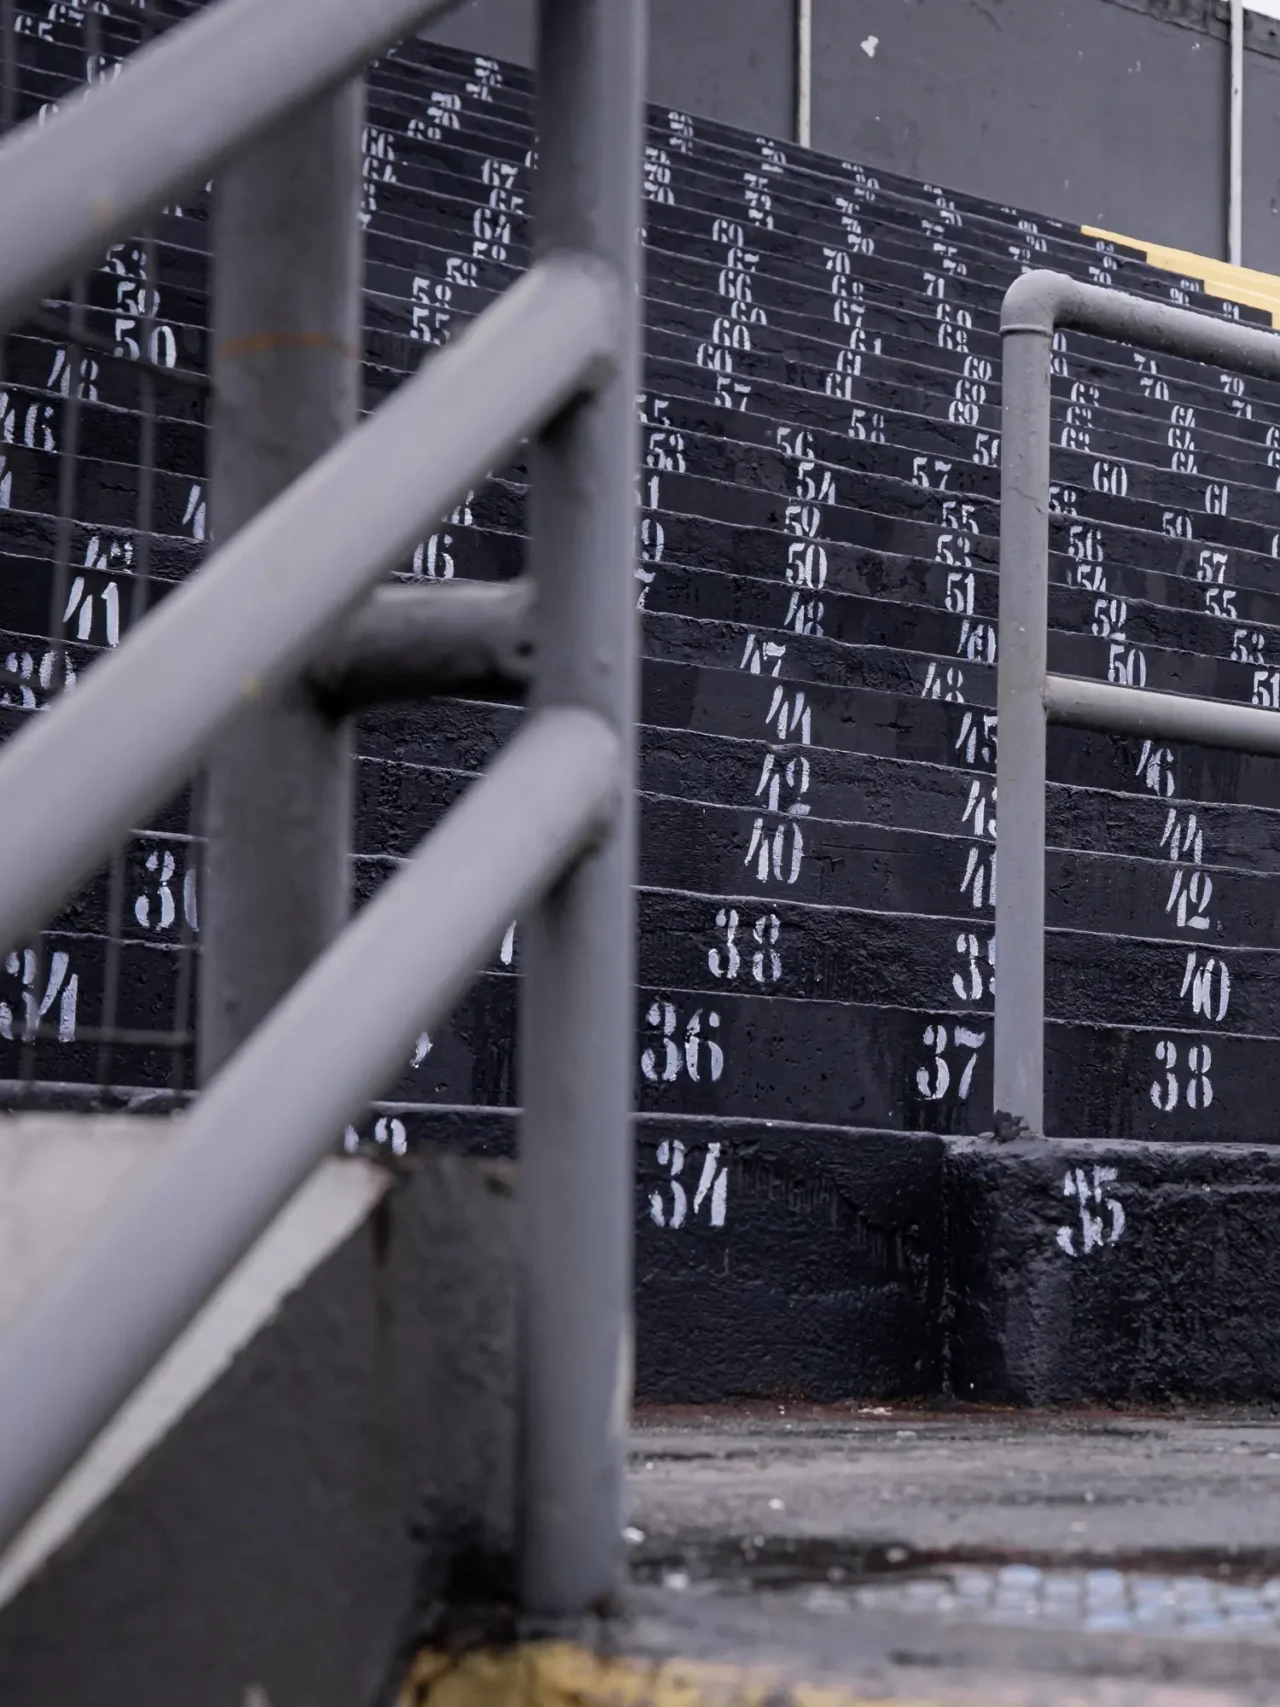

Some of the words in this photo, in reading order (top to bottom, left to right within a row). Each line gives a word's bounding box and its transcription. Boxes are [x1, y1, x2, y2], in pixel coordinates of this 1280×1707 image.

[361, 128, 395, 160] 66
[481, 159, 518, 189] 67
[472, 208, 511, 244] 64
[718, 269, 751, 302] 66
[114, 318, 177, 369] 50
[47, 349, 98, 401] 48
[647, 433, 686, 473] 53
[912, 457, 951, 490] 57
[797, 462, 836, 505] 54
[1093, 461, 1128, 497] 60
[942, 501, 979, 534] 55
[1205, 485, 1228, 517] 61
[1069, 526, 1103, 562] 56
[785, 543, 827, 589] 50
[1198, 550, 1227, 584] 57
[62, 576, 120, 647] 41
[784, 591, 824, 637] 48
[945, 572, 975, 615] 51
[1205, 589, 1237, 619] 55
[1092, 600, 1126, 641] 52
[740, 634, 785, 677] 47
[1108, 644, 1146, 687] 50
[1231, 630, 1264, 664] 53
[921, 663, 964, 703] 48
[1252, 671, 1280, 708] 51
[765, 685, 811, 745] 44
[755, 754, 811, 816] 42
[1136, 740, 1175, 797] 46
[745, 818, 803, 884] 40
[1160, 809, 1202, 864] 44
[1166, 870, 1212, 929] 42
[708, 908, 781, 982] 38
[1180, 952, 1230, 1021] 40
[641, 1002, 724, 1082] 36
[917, 1024, 986, 1099] 37
[1150, 1041, 1213, 1112] 38
[649, 1139, 728, 1229] 34
